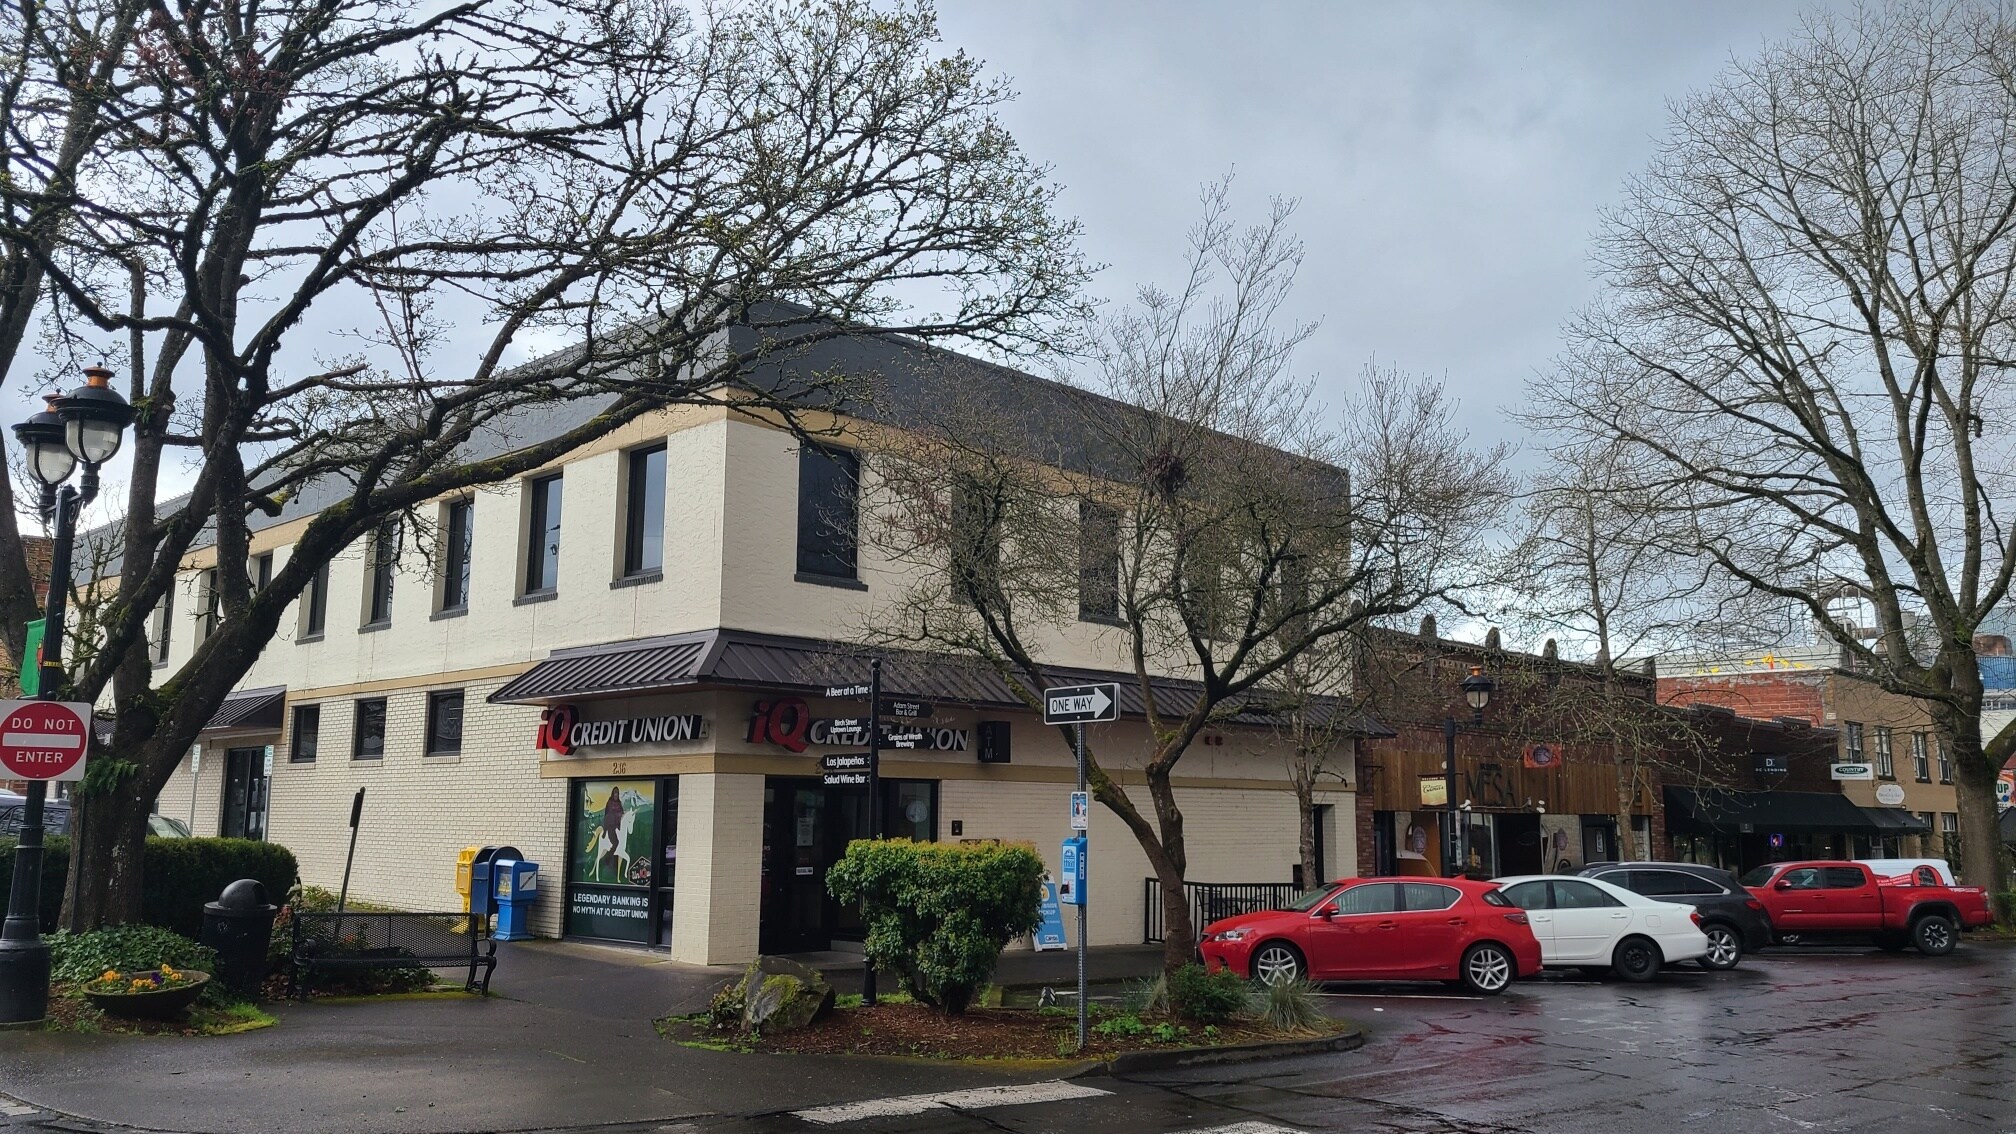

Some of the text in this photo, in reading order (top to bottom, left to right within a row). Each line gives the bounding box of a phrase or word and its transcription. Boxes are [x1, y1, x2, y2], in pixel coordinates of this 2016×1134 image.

[825, 688, 831, 697] A
[831, 687, 843, 696] Beer
[843, 687, 850, 696] at
[854, 685, 869, 695] Time
[907, 702, 920, 710] Street
[1052, 696, 1093, 712] ONE WAY
[908, 709, 918, 717] Grill
[12, 717, 75, 731] DO NOT
[751, 701, 809, 753] iQ
[834, 719, 845, 727] Birch
[536, 704, 694, 756] iQ CREDIT UNION
[830, 726, 862, 734] Uptown Lounge
[888, 732, 923, 741] Grains of Wrath
[895, 740, 915, 749] Brewing
[984, 725, 993, 759] ATM
[15, 751, 64, 764] ENTER
[826, 757, 836, 767] Los
[836, 755, 865, 769] Jalapeños
[824, 774, 866, 784] Salud Wine Bar
[573, 893, 649, 907] LEGENDARY BANKING IS
[572, 905, 581, 914] NO
[581, 906, 596, 915] MYTH
[595, 907, 603, 916] AT
[611, 908, 631, 918] CREDIT
[631, 910, 649, 920] UNION
